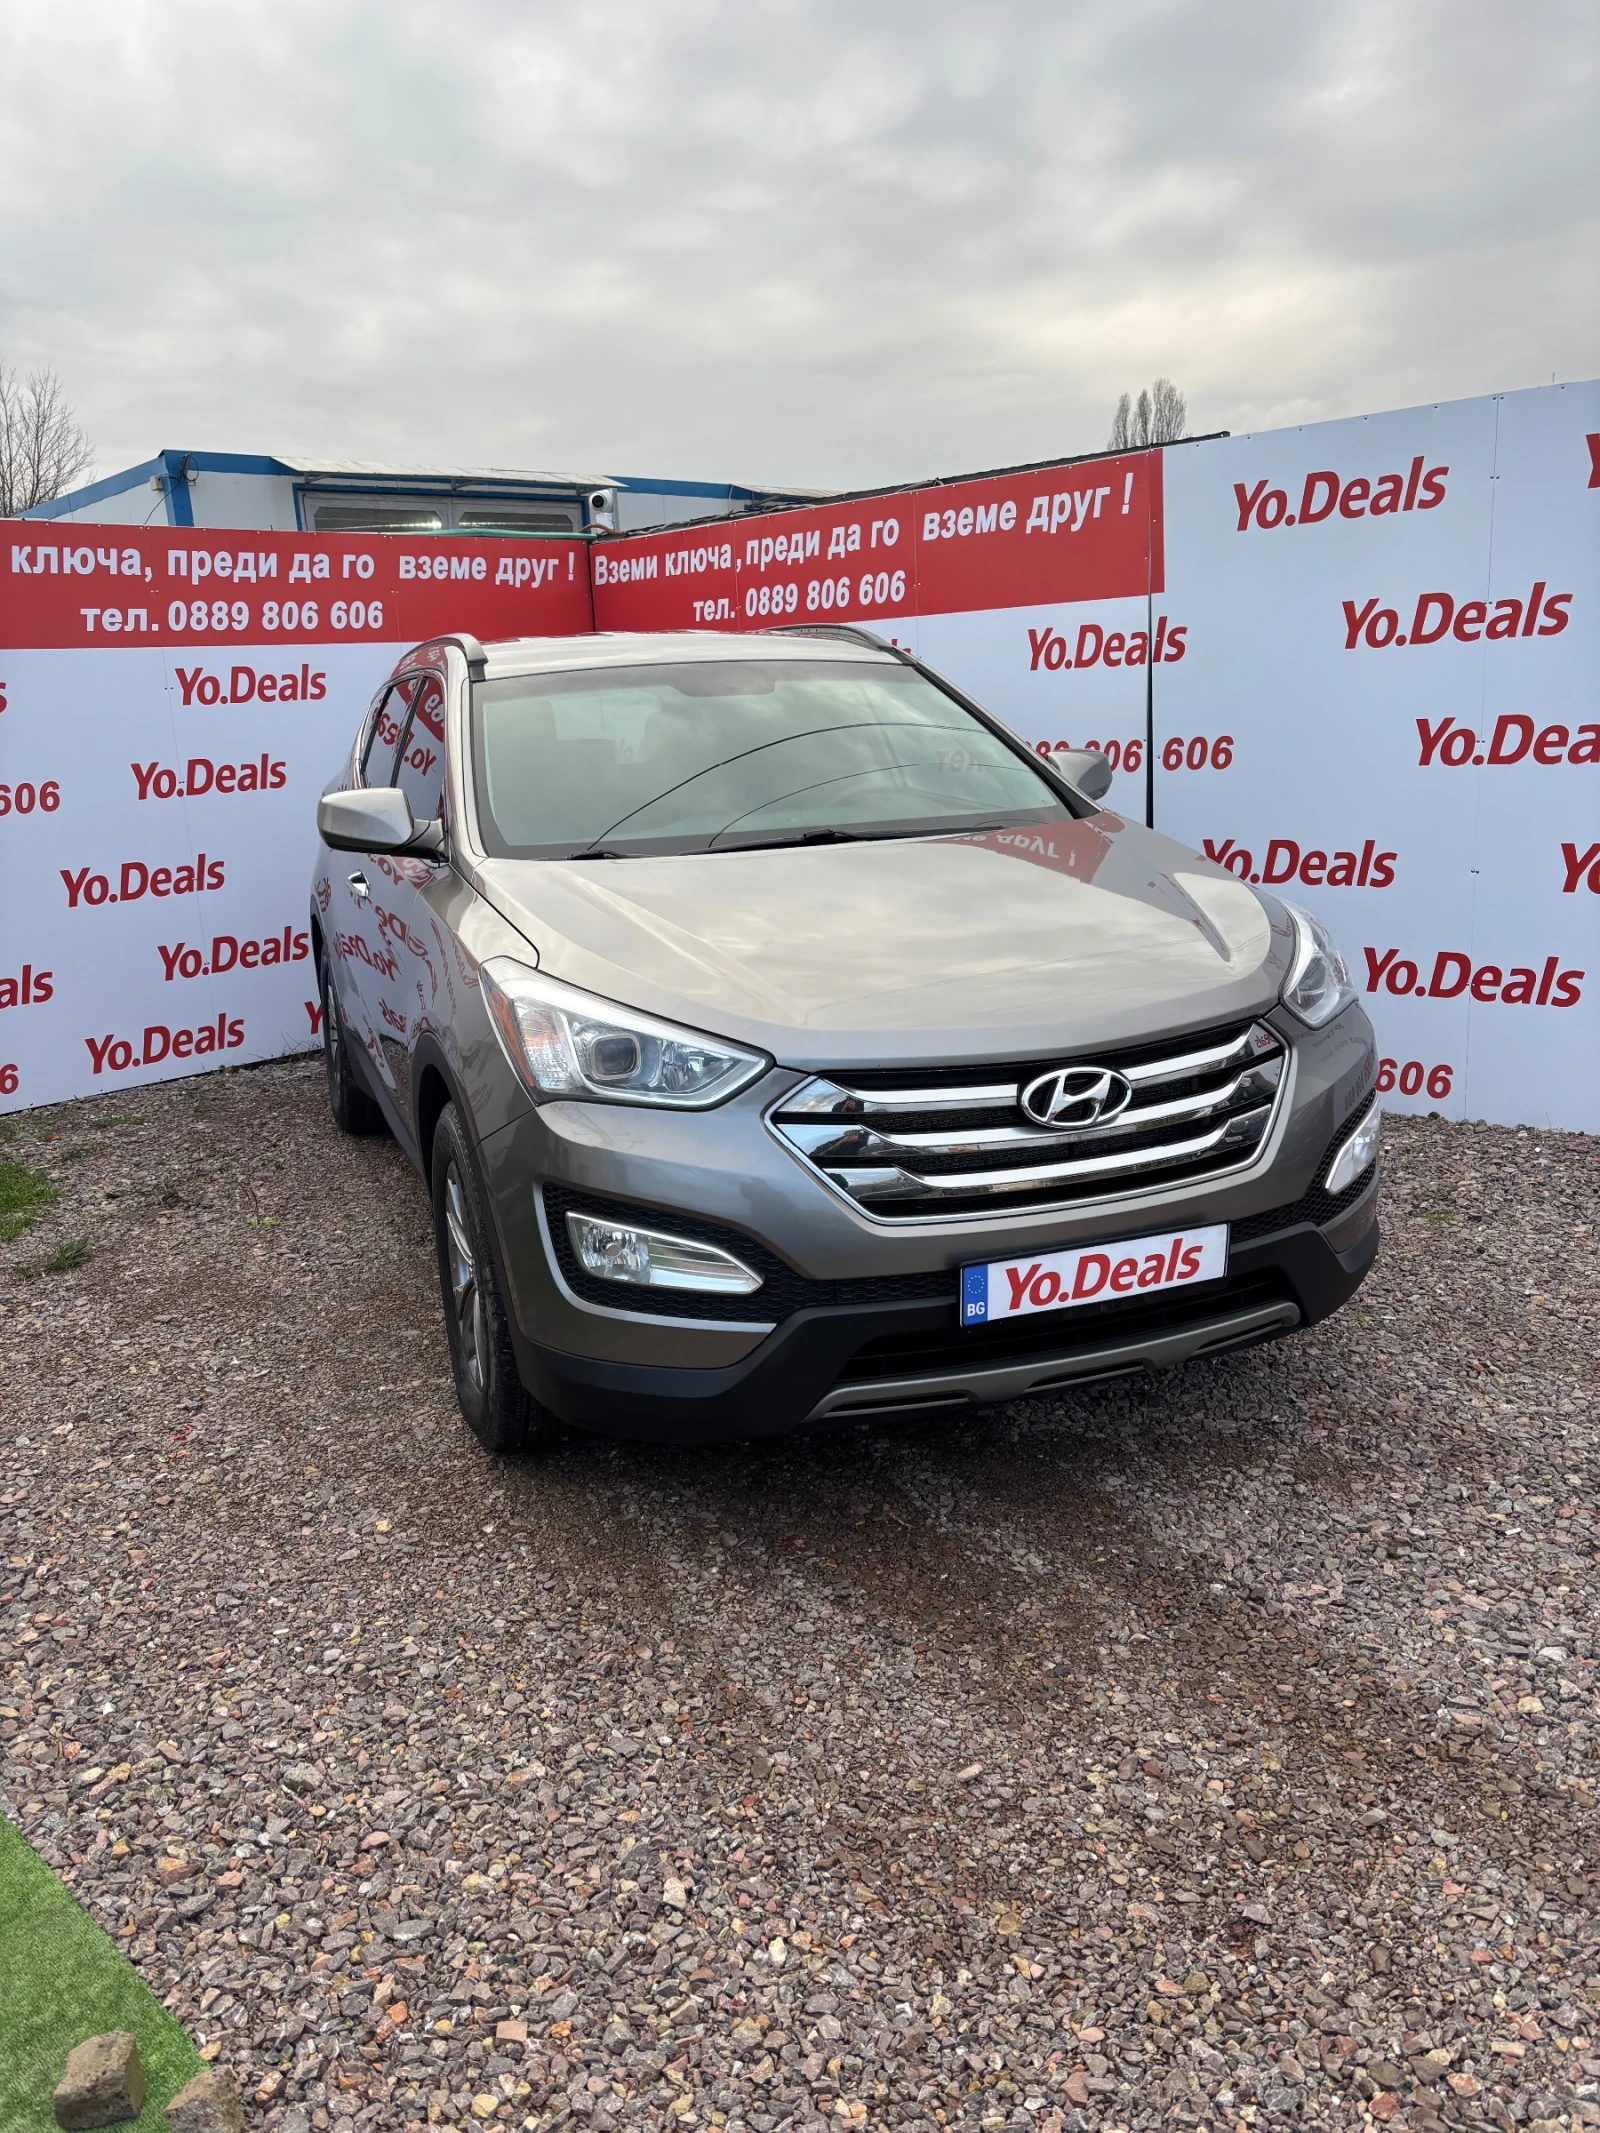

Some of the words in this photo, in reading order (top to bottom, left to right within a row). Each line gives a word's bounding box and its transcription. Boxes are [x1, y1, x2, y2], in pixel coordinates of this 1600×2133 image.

[1233, 456, 1449, 531] Yo.Deals
[595, 555, 658, 585] Вземи
[663, 545, 742, 577] ключа,
[746, 530, 821, 569] преди
[827, 523, 861, 561] да
[870, 518, 900, 548] го
[922, 500, 1017, 541] вземе
[1025, 486, 1111, 534] друг
[11, 545, 153, 583] ключа,
[167, 549, 277, 586] преди
[288, 553, 331, 584] да
[342, 554, 375, 579] го
[399, 555, 487, 580] вземе
[495, 557, 559, 589] друг
[80, 608, 159, 632] тел.
[168, 600, 250, 632] 0889
[261, 601, 319, 631] 806
[330, 600, 383, 630] 606
[693, 597, 735, 622] тел.
[745, 582, 798, 617] 0889
[806, 576, 851, 611] 806
[859, 569, 906, 606] 606
[1342, 581, 1572, 649] Yo.Deals
[1027, 616, 1187, 671] Yo.Deals
[175, 663, 326, 706] Yo.Deals
[1162, 735, 1233, 771] 606
[1416, 714, 1600, 767] Yo.Dea
[131, 753, 286, 800] Yo.Deals
[60, 853, 224, 908] Yo.Deals
[1203, 839, 1397, 888] Yo.Deals
[158, 926, 309, 981] Yo.Deals
[1364, 947, 1585, 1008] Yo.Deals
[85, 1013, 244, 1074] Yo.Deals
[1375, 1059, 1453, 1099] 606
[1005, 1238, 1203, 1311] Yo.Deals
[967, 1301, 985, 1317] BG
